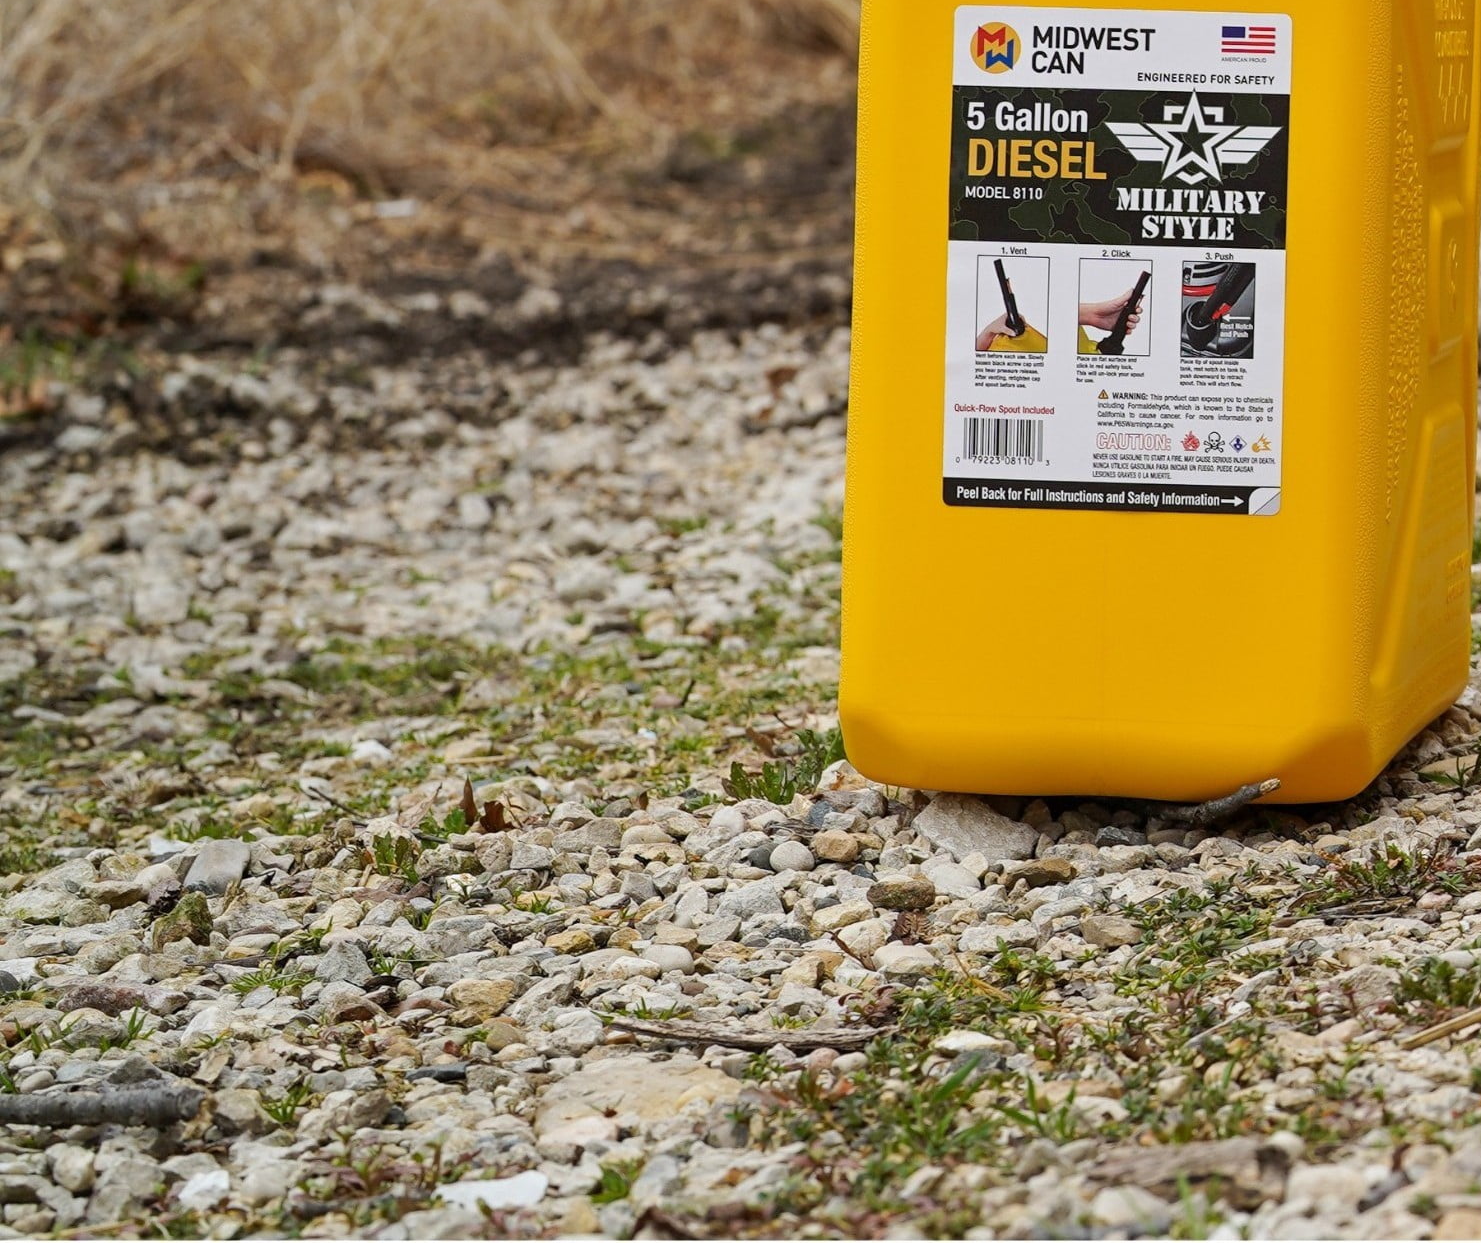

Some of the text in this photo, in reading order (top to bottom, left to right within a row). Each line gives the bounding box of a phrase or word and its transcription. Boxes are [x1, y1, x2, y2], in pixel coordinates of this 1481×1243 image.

[1033, 25, 1156, 51] MIDWEST
[1032, 51, 1085, 74] CAN
[1137, 73, 1275, 84] ENGINEERED FOR SAFETY
[967, 101, 1088, 132] 5 Gallon
[968, 138, 1107, 179] DIESEL
[965, 186, 1043, 200] MODEL 8110
[1116, 188, 1266, 214] MILITARY
[1142, 215, 1234, 240] STYLE
[1010, 247, 1027, 255] Vent
[1214, 253, 1234, 261] Push
[1112, 392, 1148, 400] WARNING:
[954, 404, 1054, 415] Quick-Flow Spout Included
[1096, 432, 1171, 451] CAUTION:
[973, 456, 1001, 464] 79223
[1005, 457, 1034, 465] 08110
[957, 486, 1220, 507] Peel Back for Full Instructions and Safety Information
